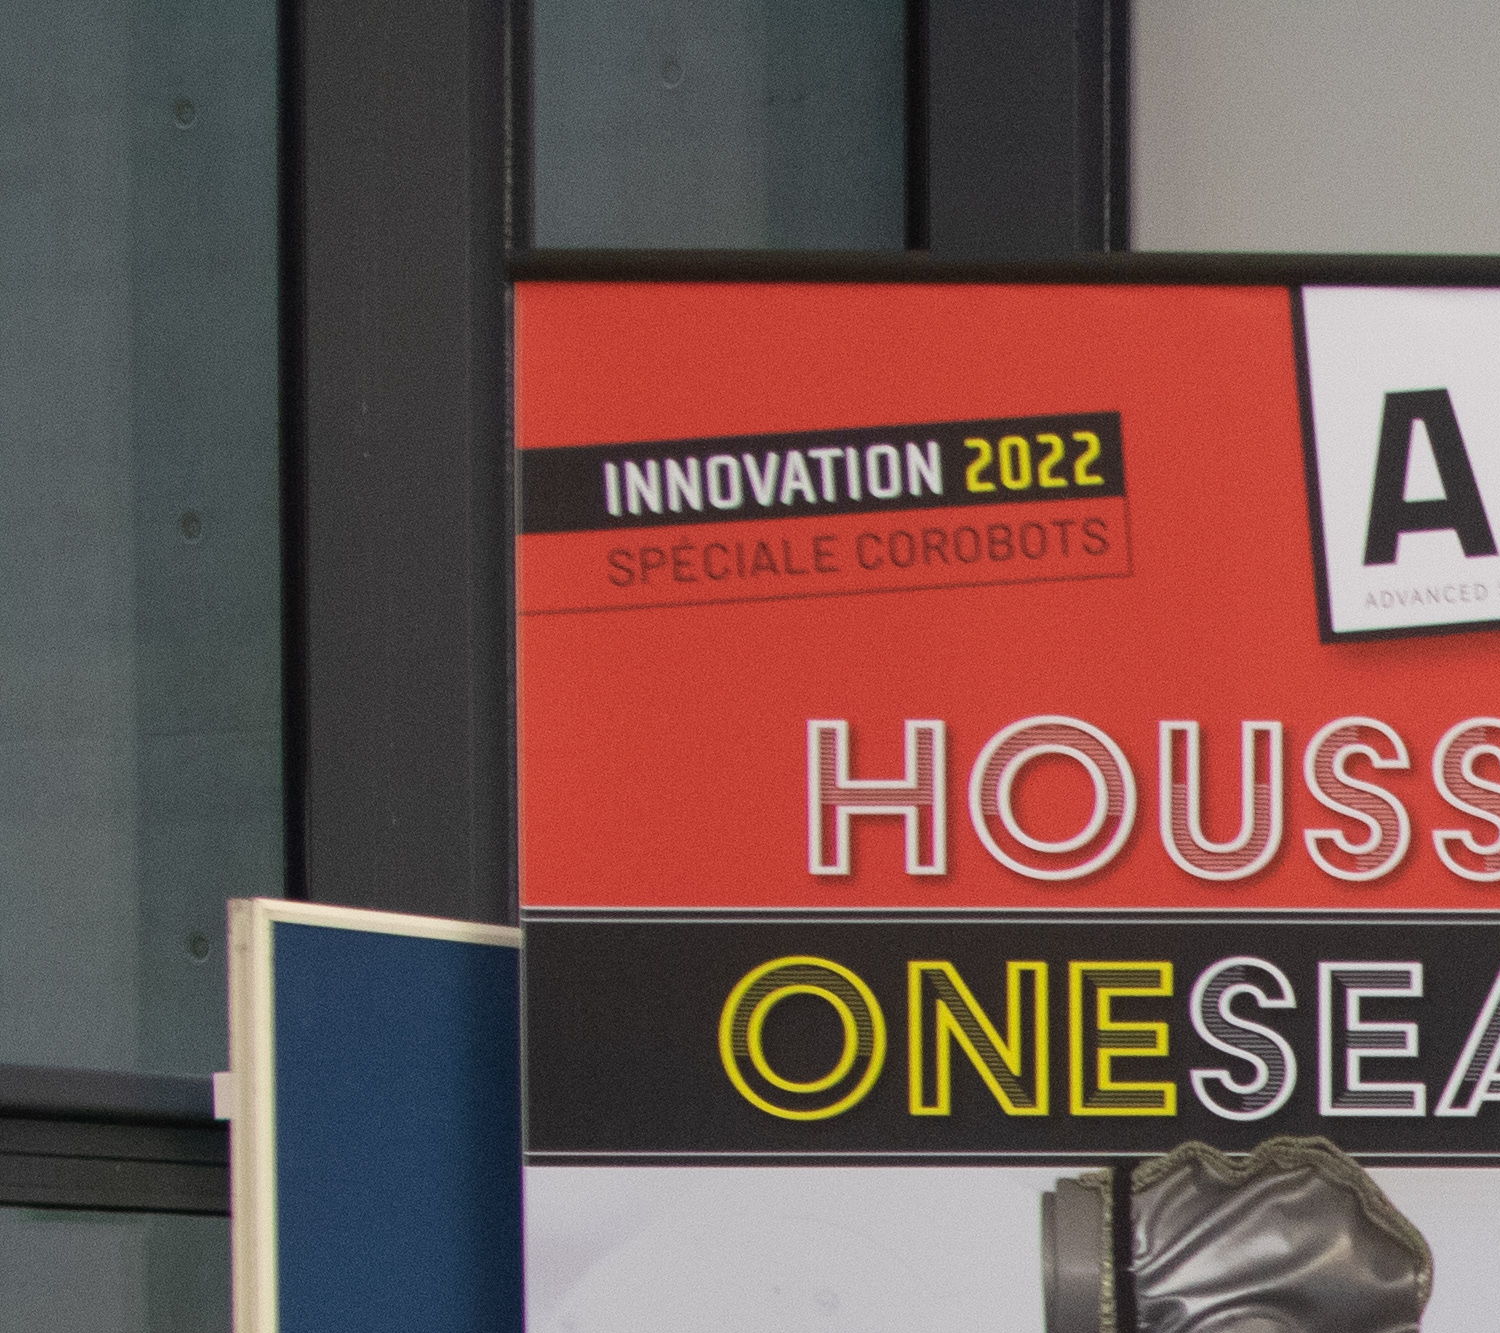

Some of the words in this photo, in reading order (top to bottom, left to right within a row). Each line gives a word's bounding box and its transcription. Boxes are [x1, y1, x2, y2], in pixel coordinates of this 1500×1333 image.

[604, 440, 943, 517] INNOVATION
[964, 431, 1104, 494] 2022
[607, 533, 840, 588] SPÉCIALE
[856, 518, 1111, 571] COROBOTS
[1364, 582, 1487, 610] ADVANCED
